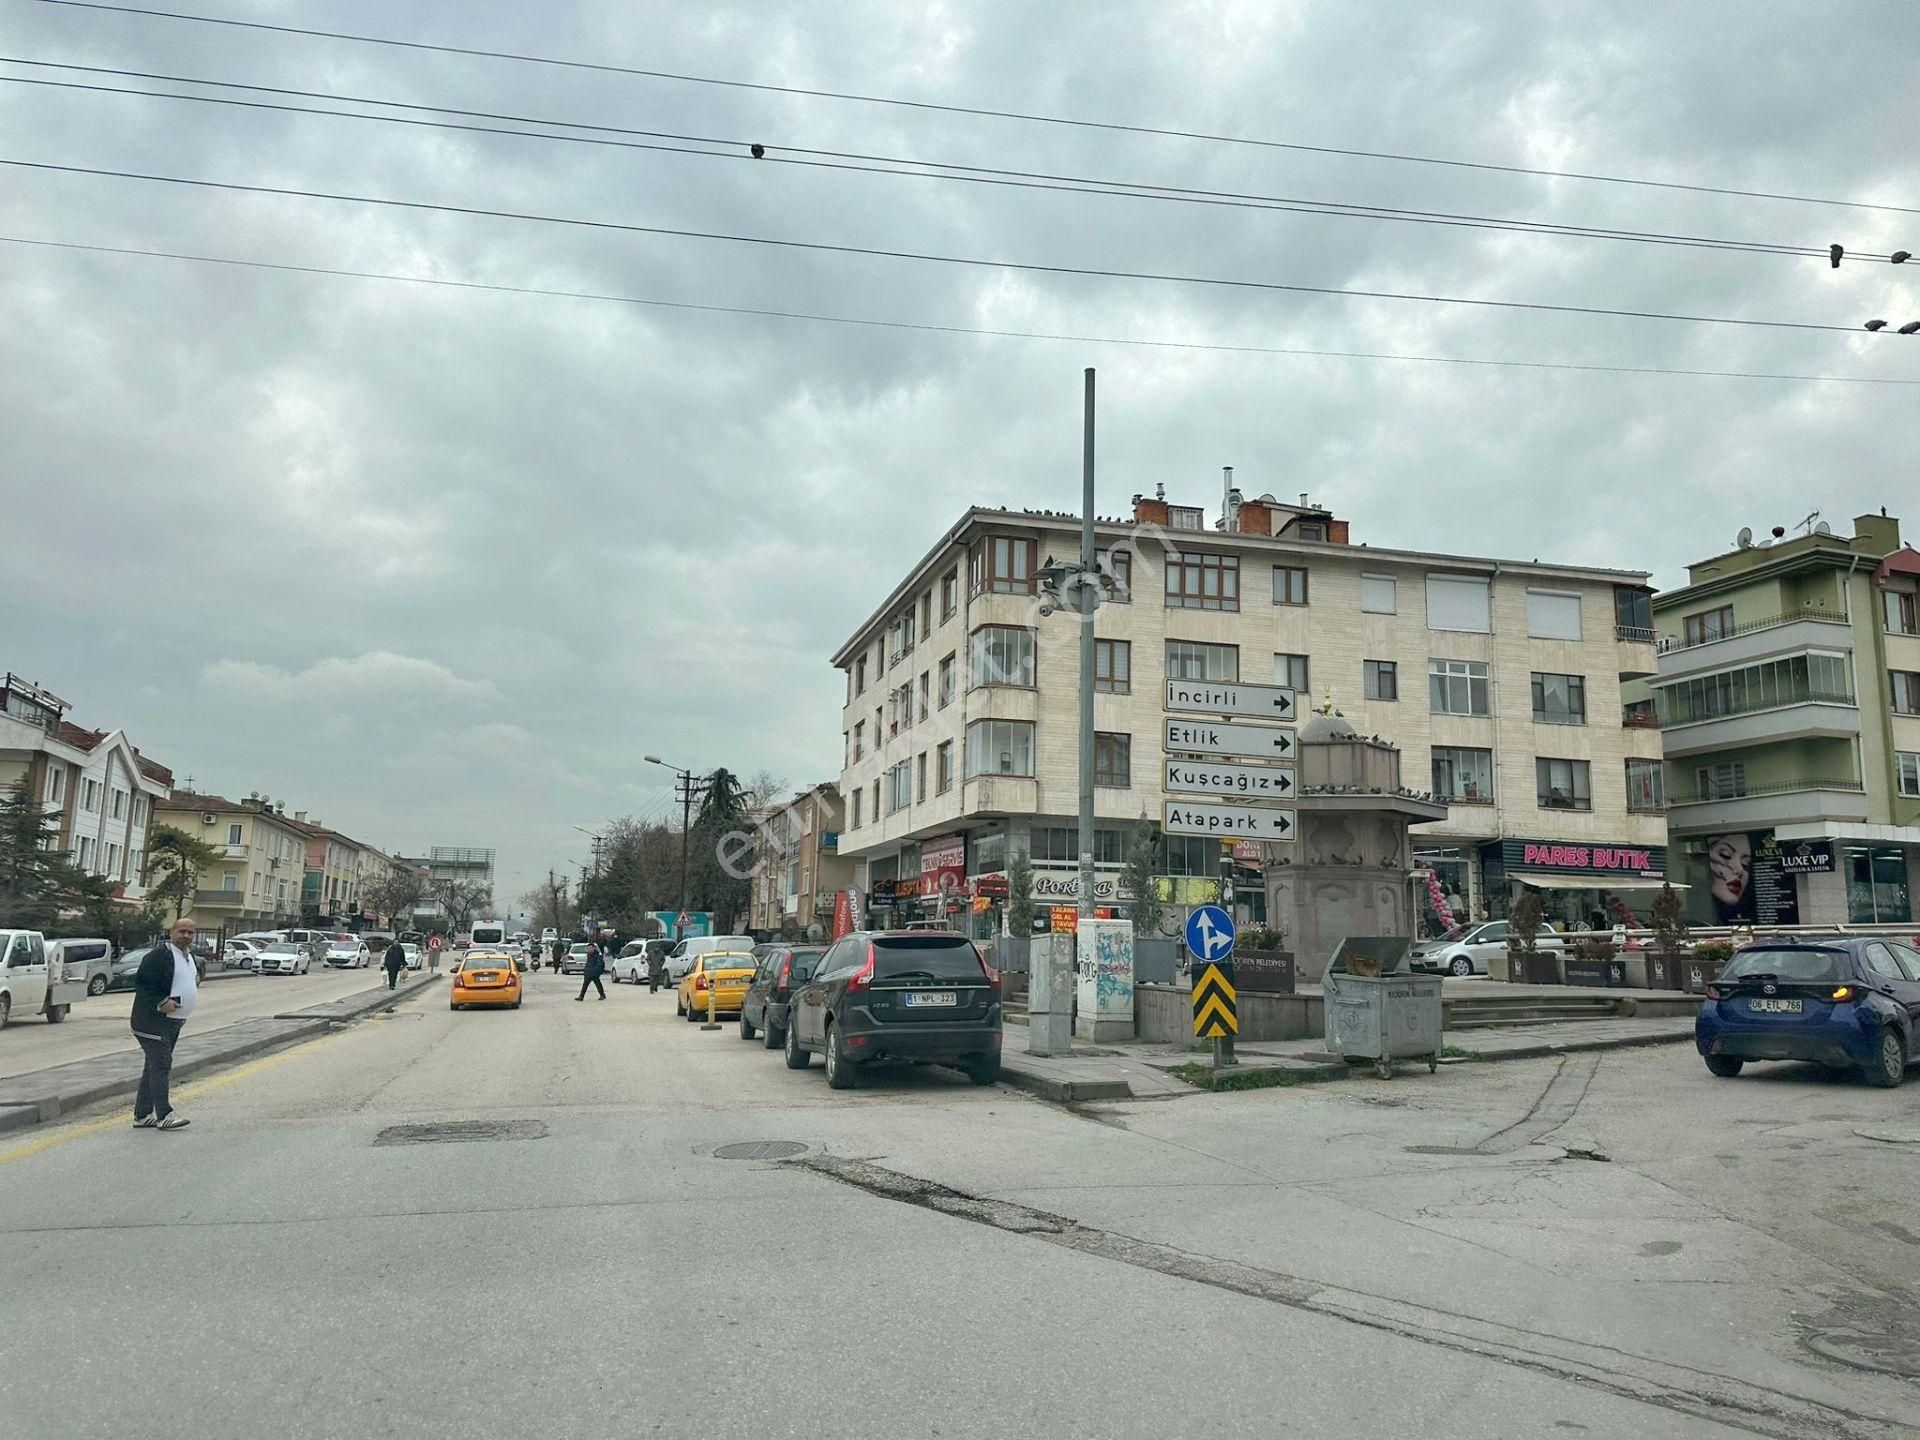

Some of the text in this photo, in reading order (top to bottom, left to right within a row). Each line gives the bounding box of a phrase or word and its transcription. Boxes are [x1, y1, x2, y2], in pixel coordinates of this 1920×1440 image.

[1169, 683, 1236, 706] İncirli
[1169, 727, 1219, 745] Etlik
[1169, 768, 1269, 790] Kuşcağız
[1169, 809, 1257, 831] Atapark
[1524, 844, 1589, 867] PARES
[1774, 847, 1783, 856] VI
[1782, 854, 1829, 867] LUXE VIP
[921, 995, 936, 1003] NPL
[940, 994, 955, 1002] 323
[1752, 999, 1763, 1009] 06
[1766, 1000, 1781, 1009] ETL
